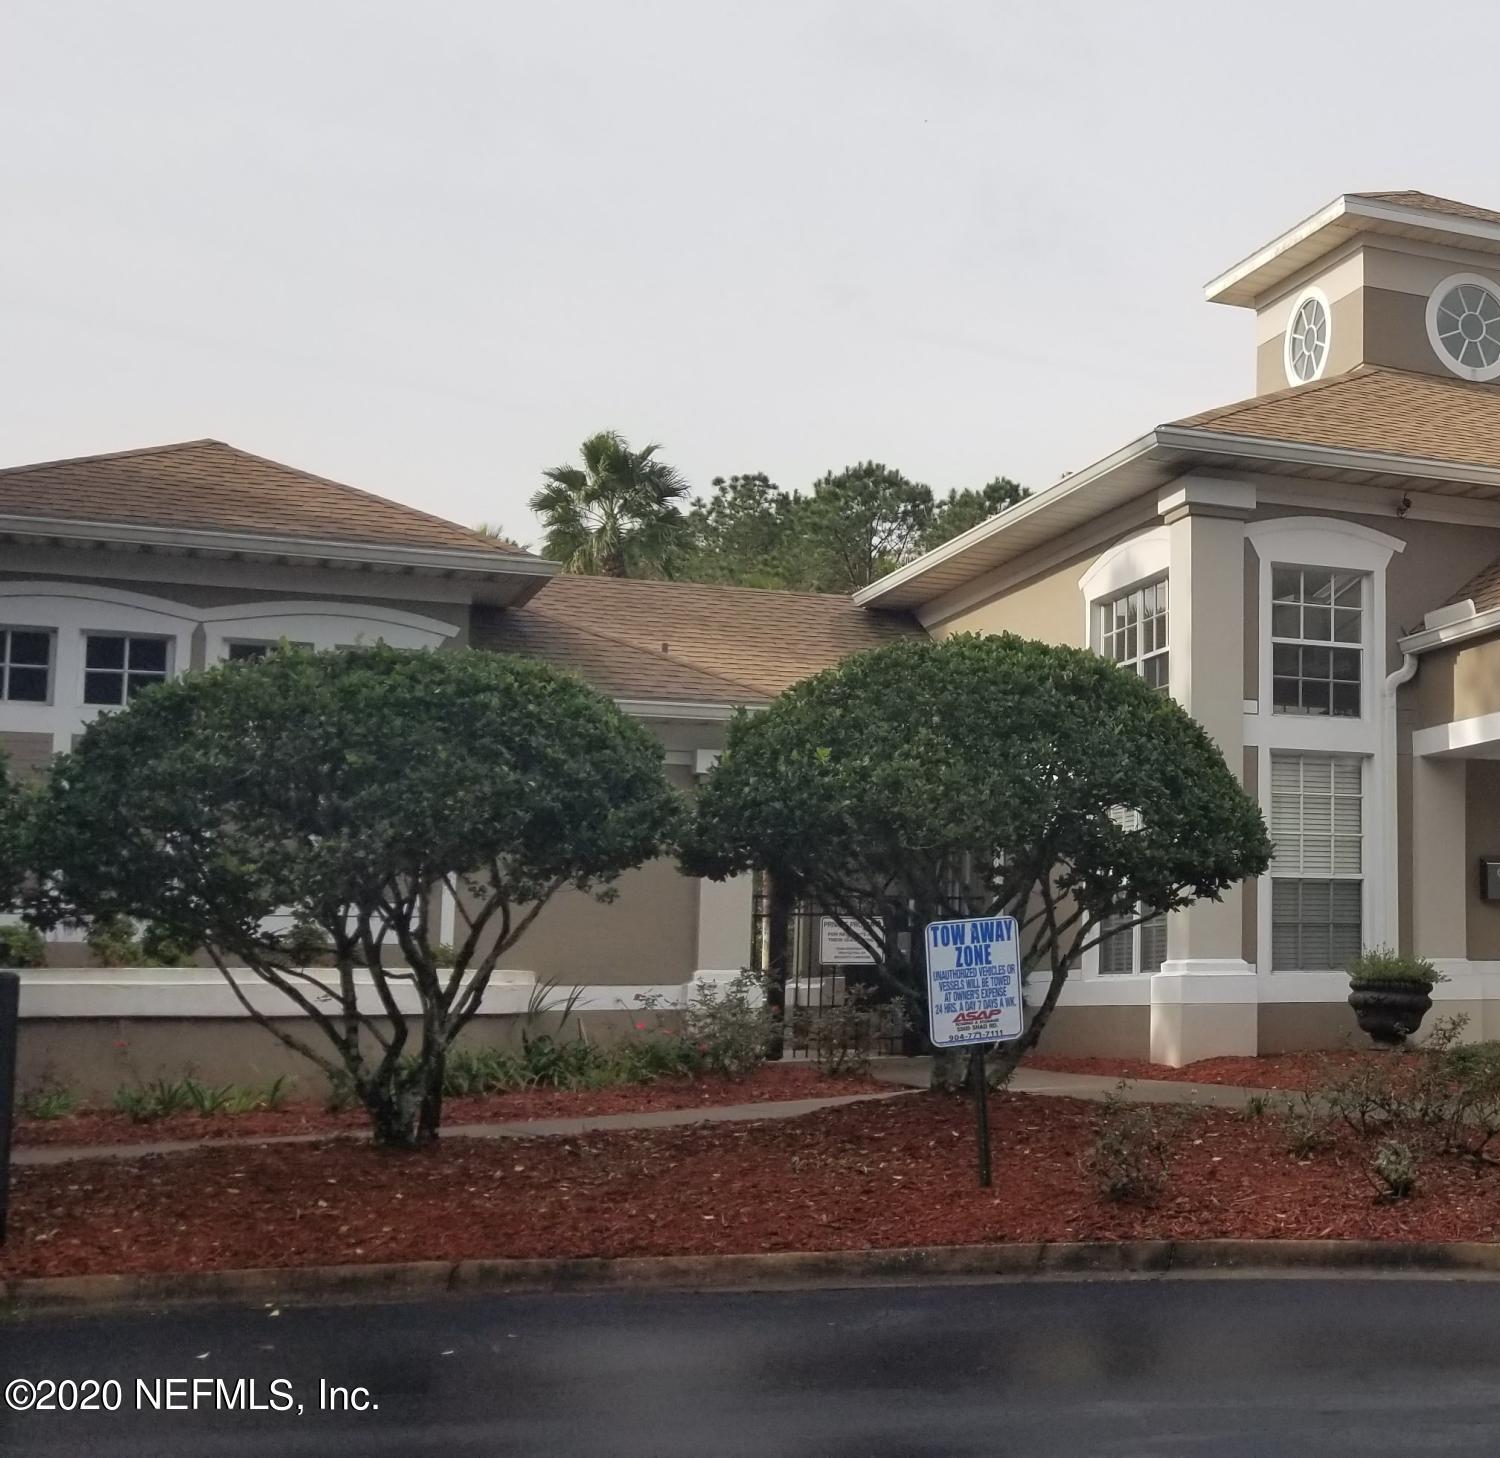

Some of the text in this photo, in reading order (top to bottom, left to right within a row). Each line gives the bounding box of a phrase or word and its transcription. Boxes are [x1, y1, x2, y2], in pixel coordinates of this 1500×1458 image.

[931, 920, 1013, 947] TOW AWAY
[955, 944, 992, 968] ZONE
[933, 964, 1016, 981] UNAUTHORIZED VEHICLES OR
[939, 975, 1011, 992] VESSELS WILL BE TOWED
[944, 987, 1007, 1002] AT OWNER'S EXPENSE
[935, 1005, 943, 1015] 24
[960, 1002, 964, 1011] A
[965, 1001, 976, 1011] DAY
[977, 1000, 981, 1010] 7
[982, 998, 998, 1010] DAYS
[1000, 998, 1004, 1008] A
[952, 1008, 1002, 1023] ASAP
